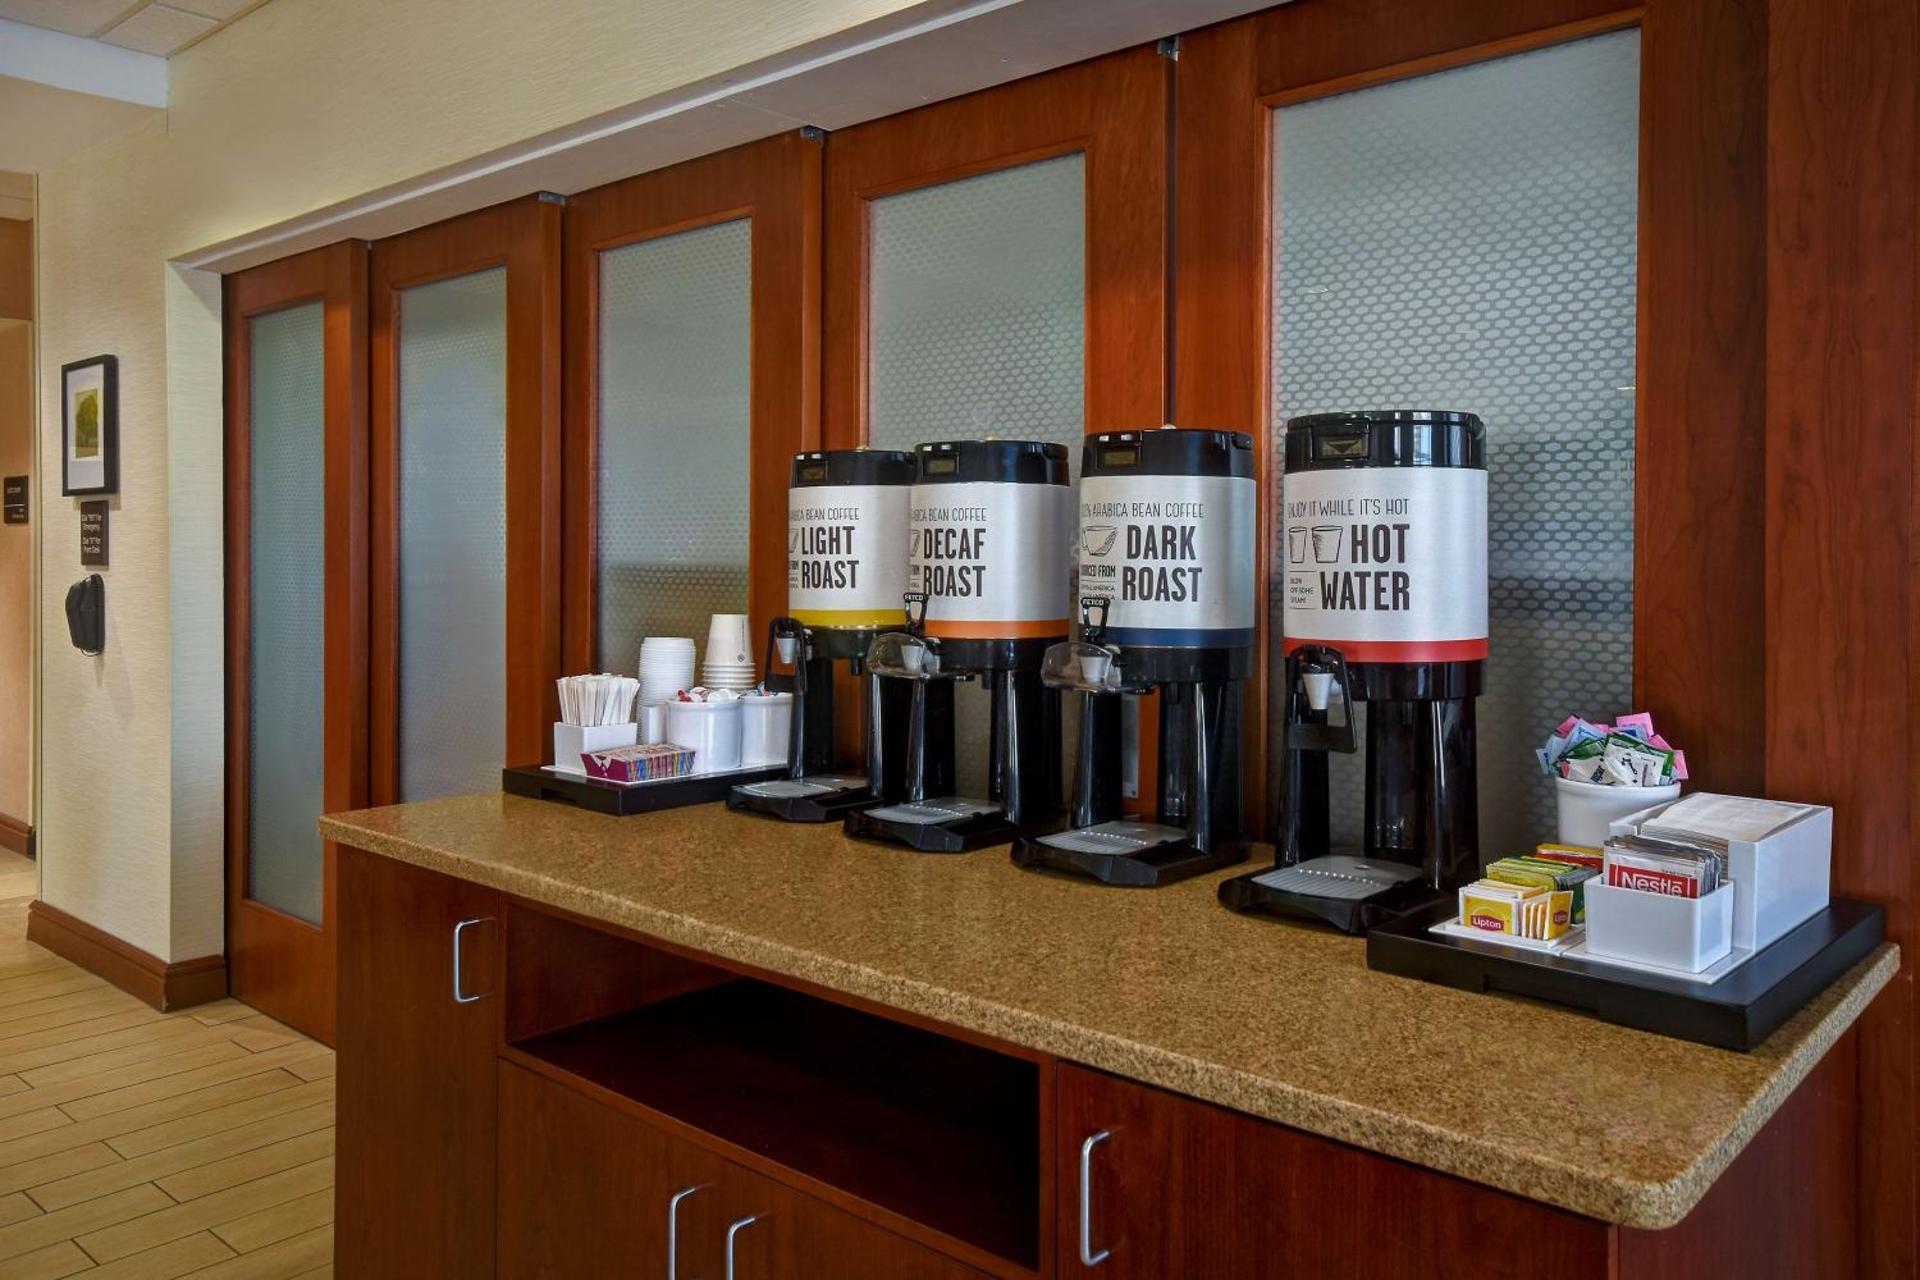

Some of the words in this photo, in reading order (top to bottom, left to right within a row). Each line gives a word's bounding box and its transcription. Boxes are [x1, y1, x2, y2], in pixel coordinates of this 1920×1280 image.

[828, 507, 860, 520] COFFEE
[928, 508, 949, 521] BEAN
[952, 507, 987, 521] COFFEE
[1132, 502, 1161, 517] BEAN
[1165, 502, 1205, 518] COFFEE
[1319, 499, 1355, 516] WHILE
[1360, 498, 1381, 515] IT'S
[1386, 498, 1410, 515] HOT
[801, 526, 855, 554] LIGHT
[924, 528, 986, 559] DECAF
[1127, 524, 1196, 560] DARK
[1351, 524, 1410, 563] HOT
[801, 560, 860, 588] ROAST
[923, 565, 986, 597] ROAST
[1122, 566, 1203, 602] ROAST
[1320, 571, 1410, 611] WATER
[1472, 916, 1501, 929] Lipton
